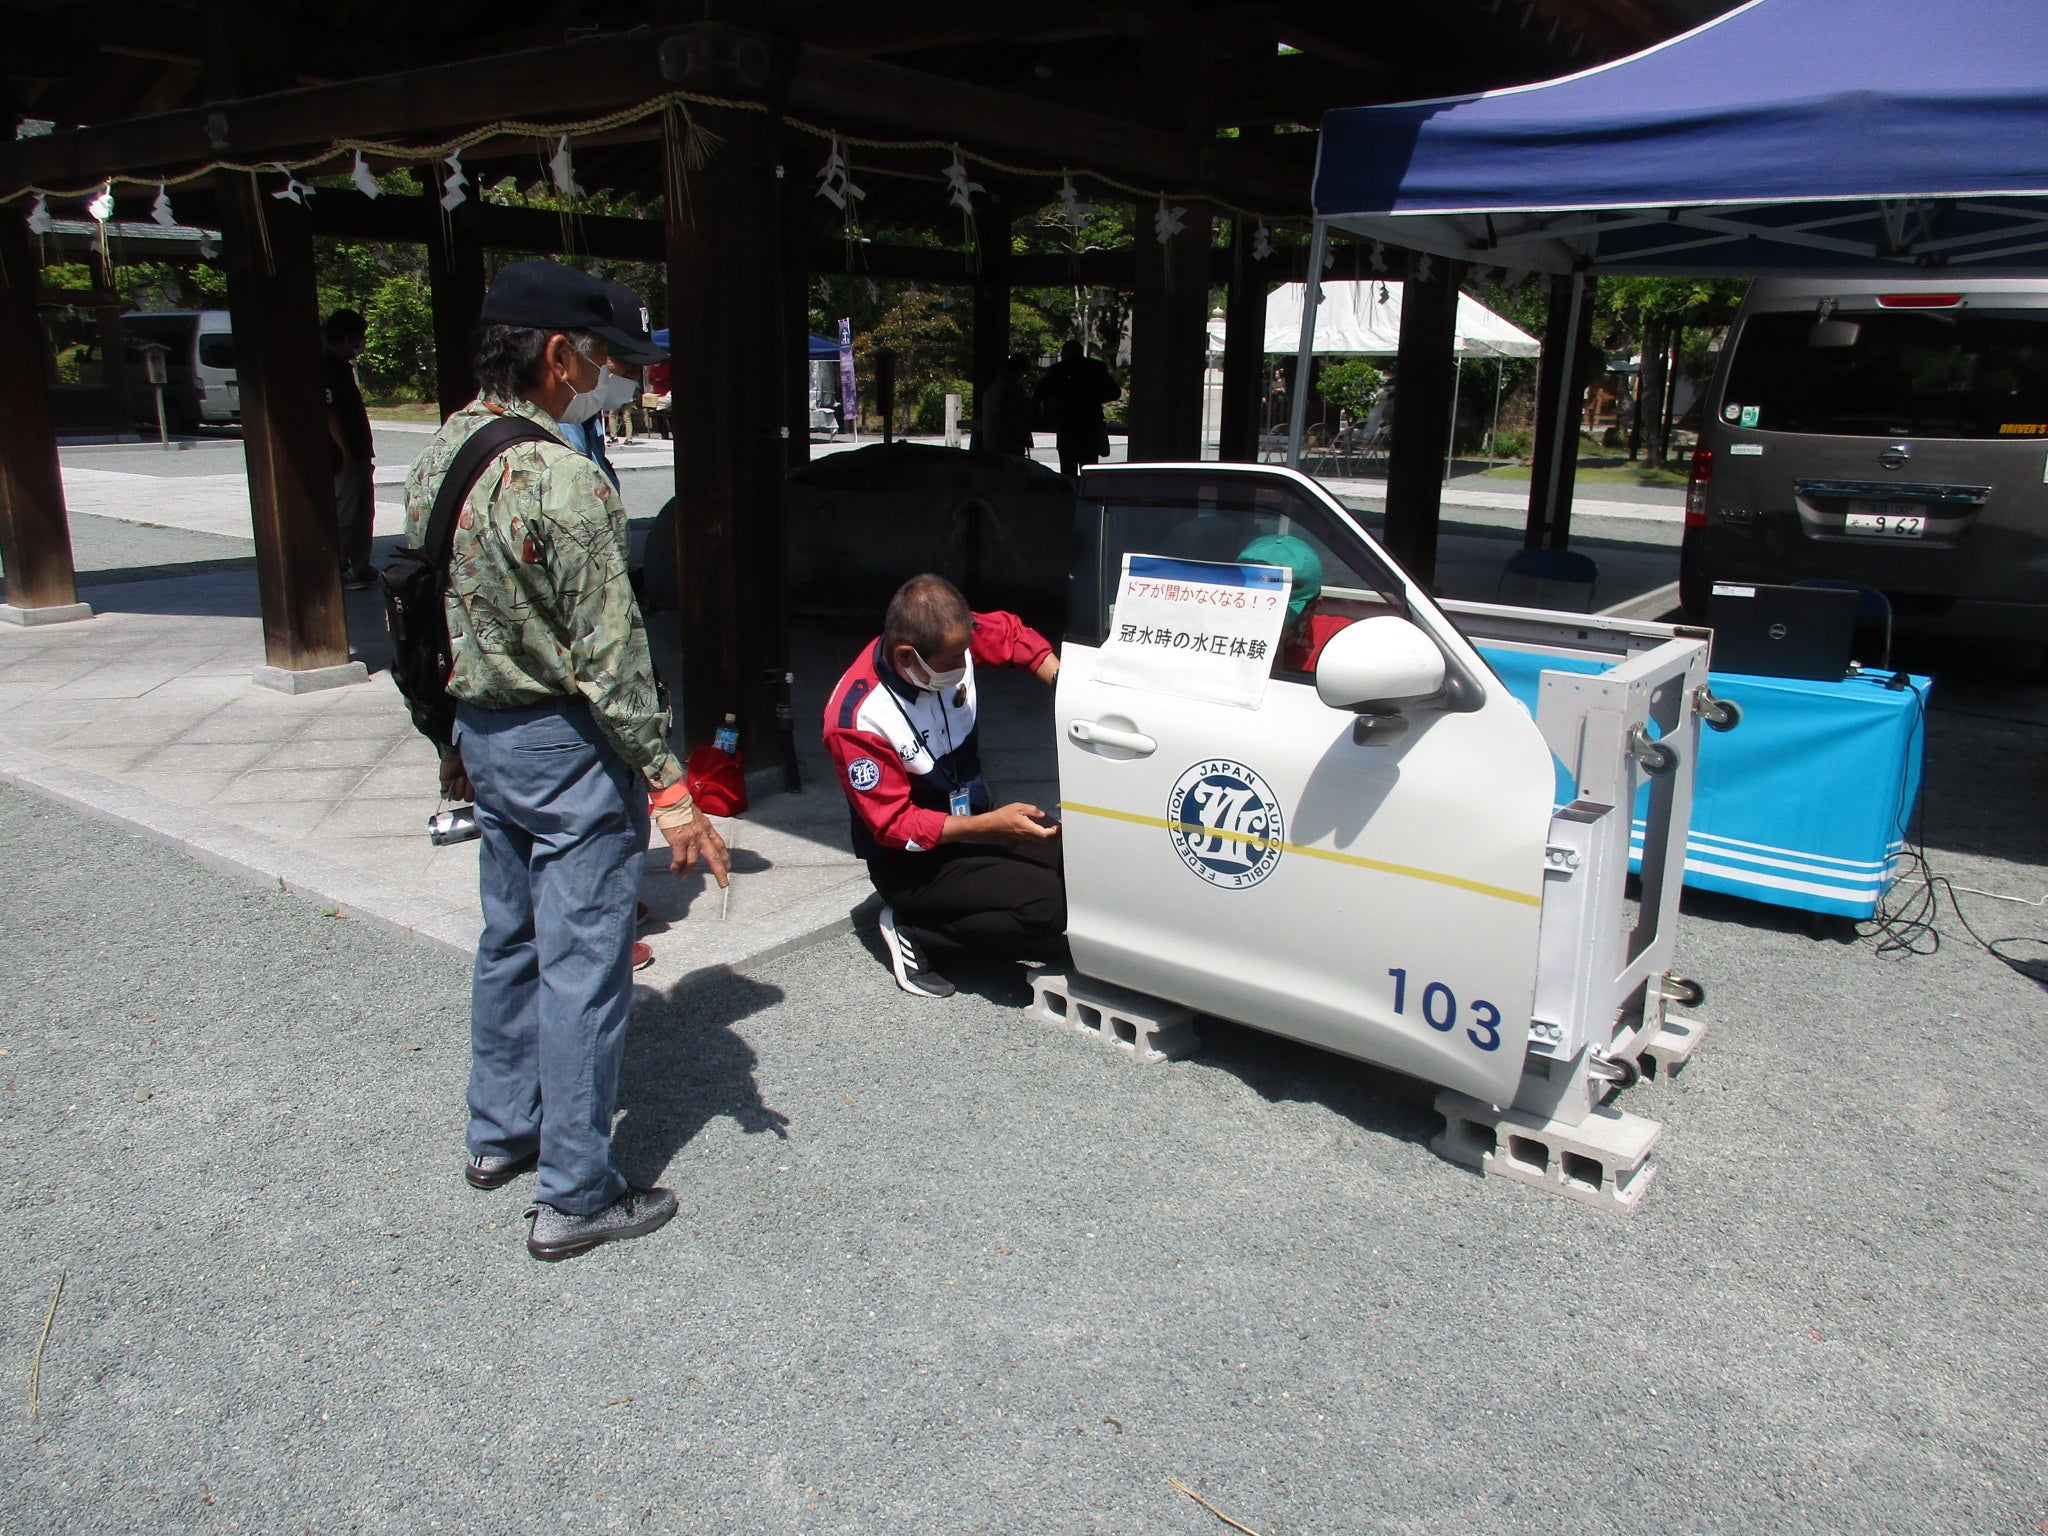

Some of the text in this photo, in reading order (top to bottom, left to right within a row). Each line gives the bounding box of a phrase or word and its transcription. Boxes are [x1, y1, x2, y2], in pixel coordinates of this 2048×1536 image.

[1118, 624, 1268, 660] 冠水時の水圧体験
[912, 730, 929, 754] JF
[1170, 763, 1280, 885] JAPAN AUTOMOBILE FEDERATION
[1388, 968, 1501, 1051] 103
